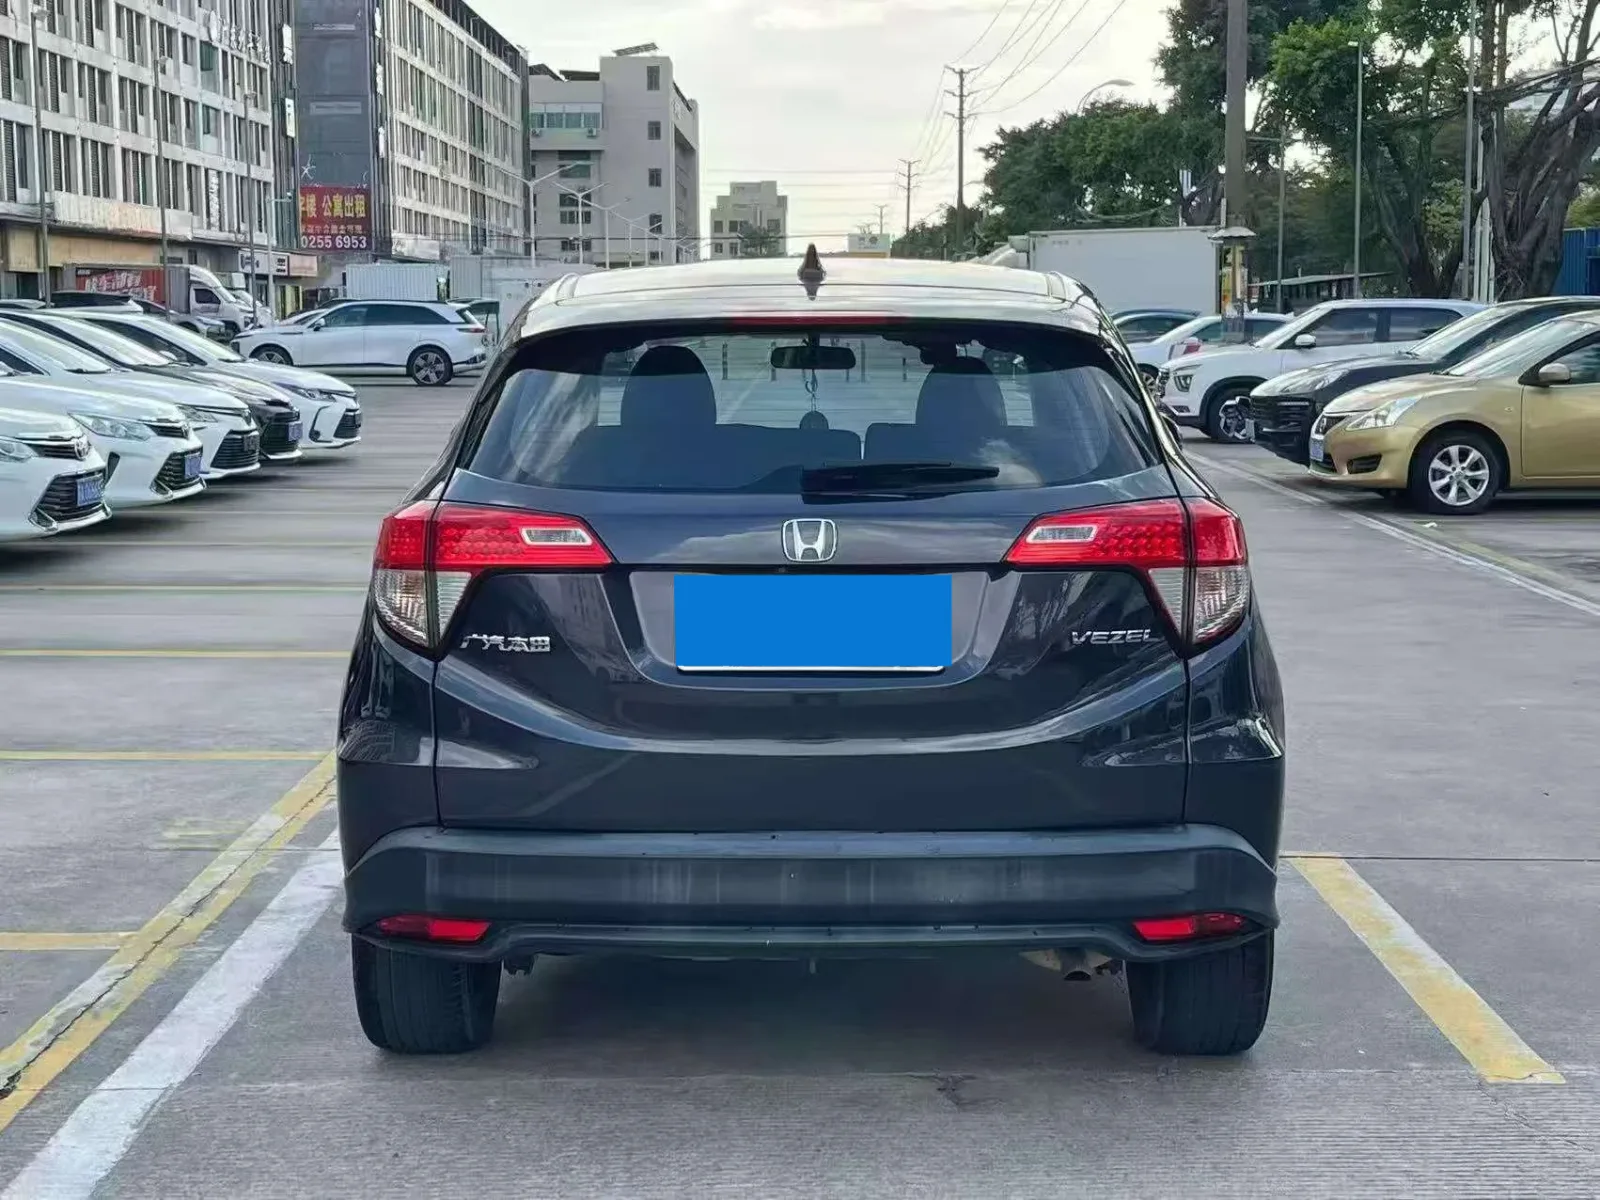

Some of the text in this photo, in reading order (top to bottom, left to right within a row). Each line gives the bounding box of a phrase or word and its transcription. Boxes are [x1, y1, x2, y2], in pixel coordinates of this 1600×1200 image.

[301, 235, 367, 248] 0255 6953
[460, 634, 550, 652] 广汽本田
